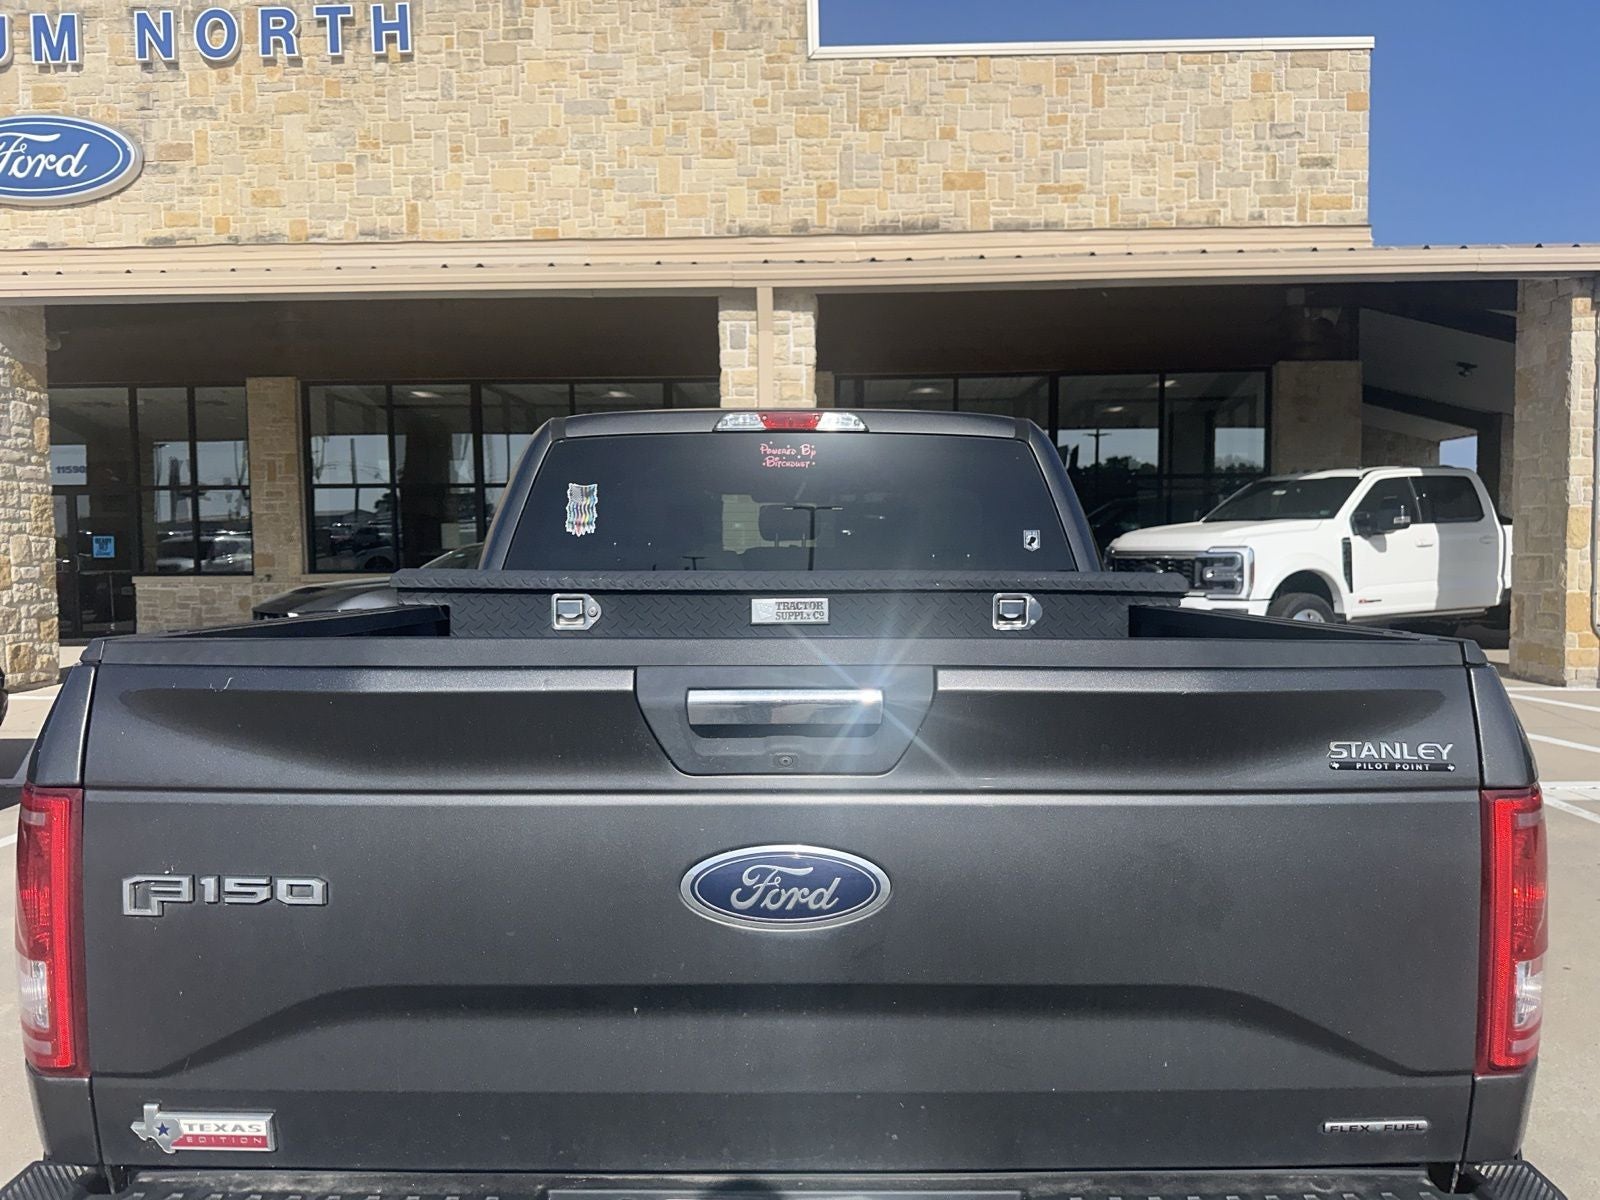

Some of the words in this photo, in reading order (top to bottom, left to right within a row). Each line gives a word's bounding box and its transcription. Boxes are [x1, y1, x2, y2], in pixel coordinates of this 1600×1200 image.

[134, 3, 413, 62] NORTH
[775, 601, 824, 611] TRACTOR
[775, 611, 811, 620] SUPPLY
[1327, 741, 1454, 760] STANLEY
[1356, 762, 1389, 770] PILOT
[1395, 763, 1430, 771] POINT
[730, 864, 842, 911] Ford
[183, 1123, 262, 1133] TEXAS
[1330, 1125, 1370, 1133] FLEX
[1384, 1123, 1425, 1131] FUEL
[186, 1136, 262, 1144] EDITION
